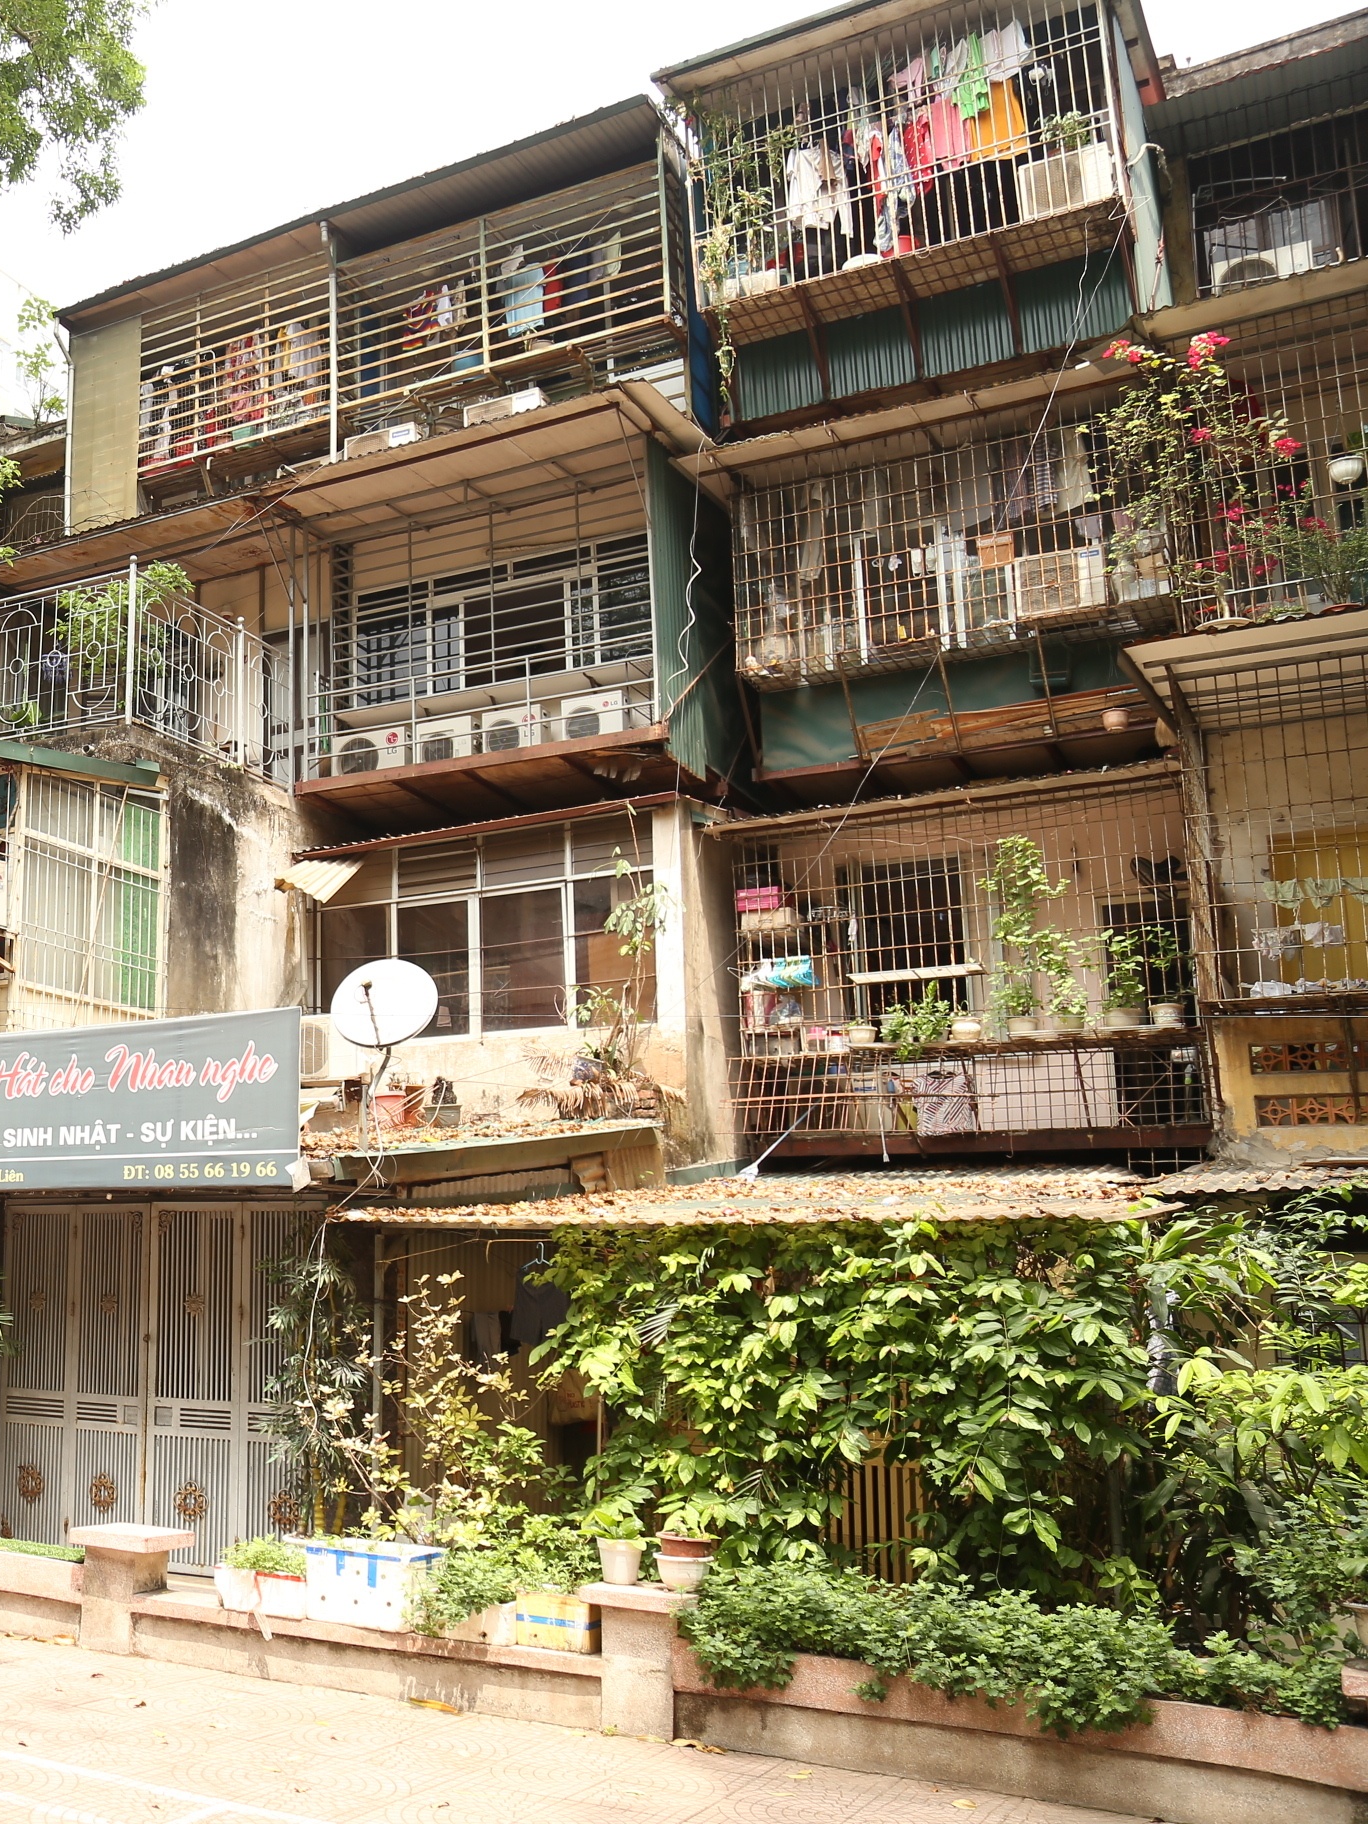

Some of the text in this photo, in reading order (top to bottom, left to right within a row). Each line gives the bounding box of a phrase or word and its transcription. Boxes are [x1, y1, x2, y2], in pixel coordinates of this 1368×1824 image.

[386, 747, 398, 755] LG
[48, 1053, 95, 1096] cho
[104, 1044, 197, 1093] Nhau
[199, 1040, 279, 1103] nghe
[3, 1127, 53, 1148] SINH
[59, 1119, 122, 1150] NHẬT
[140, 1119, 175, 1148] SỰ
[123, 1161, 277, 1180] ĐT: 08 55 66 19 66
